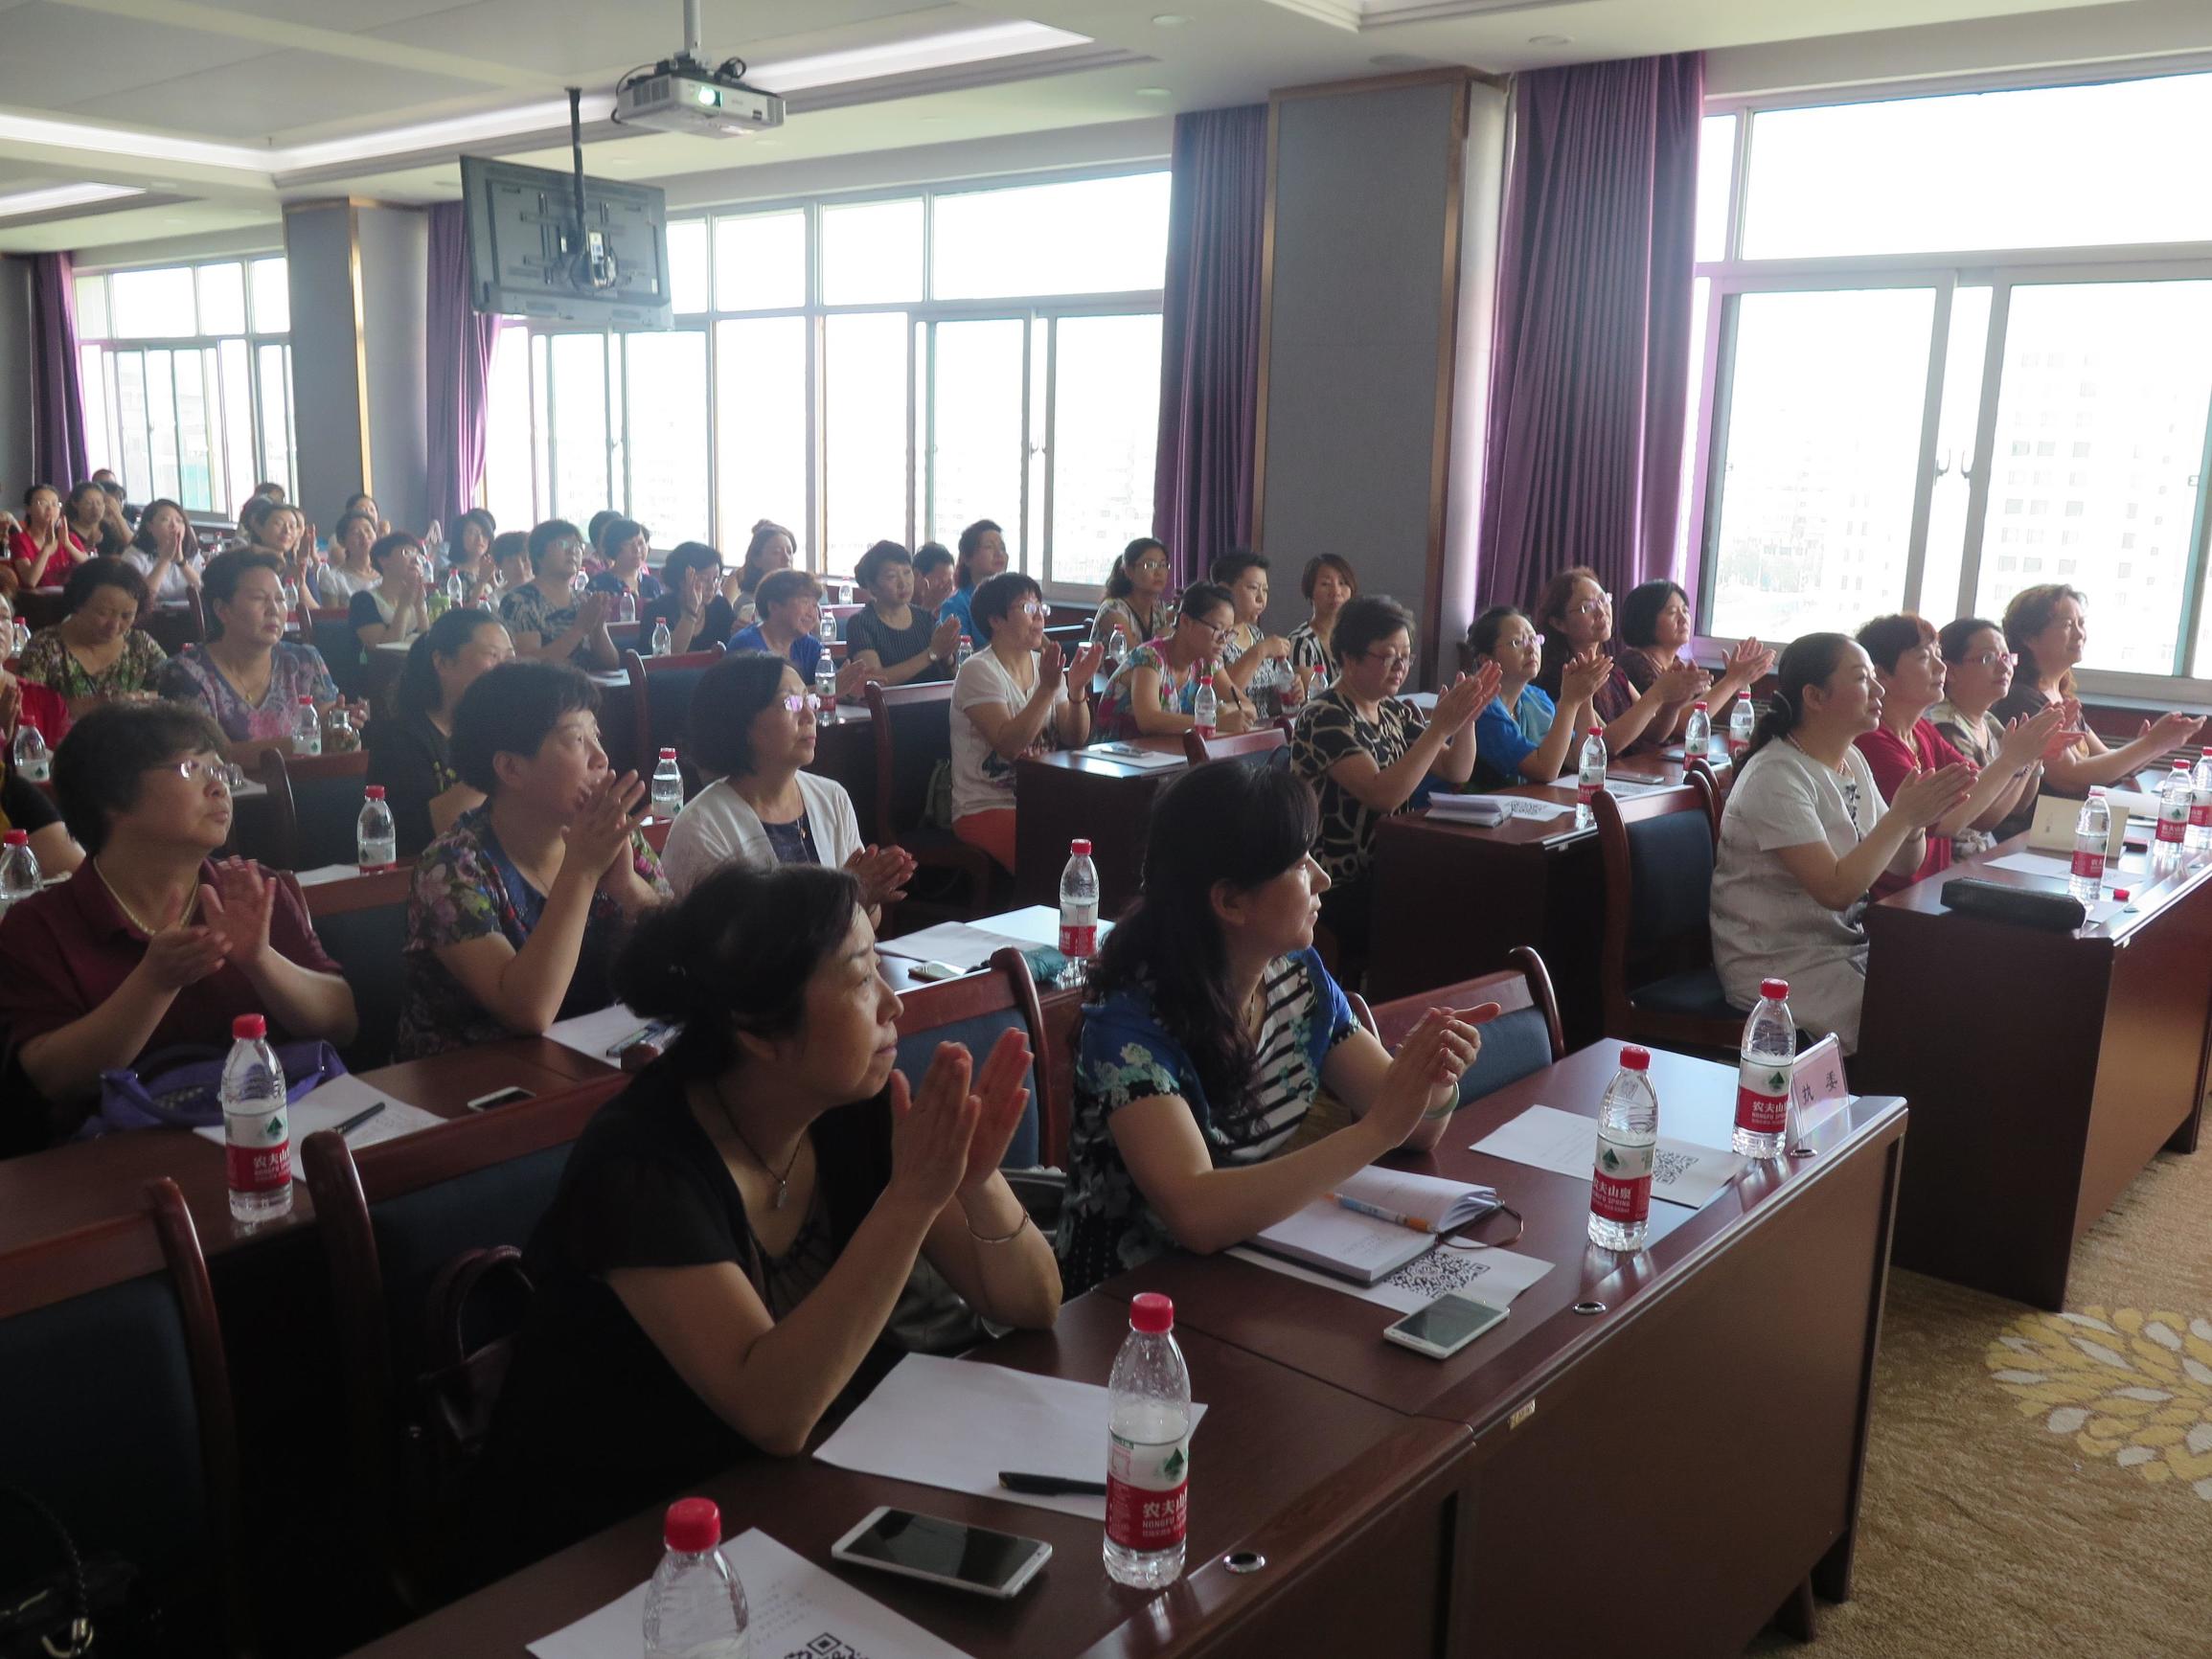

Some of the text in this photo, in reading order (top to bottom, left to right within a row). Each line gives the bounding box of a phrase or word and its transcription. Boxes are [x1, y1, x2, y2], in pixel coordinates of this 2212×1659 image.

[1752, 1101, 1788, 1113] 农夫山
[253, 1147, 290, 1169] 农夫山
[1143, 1485, 1188, 1519] 农夫山
